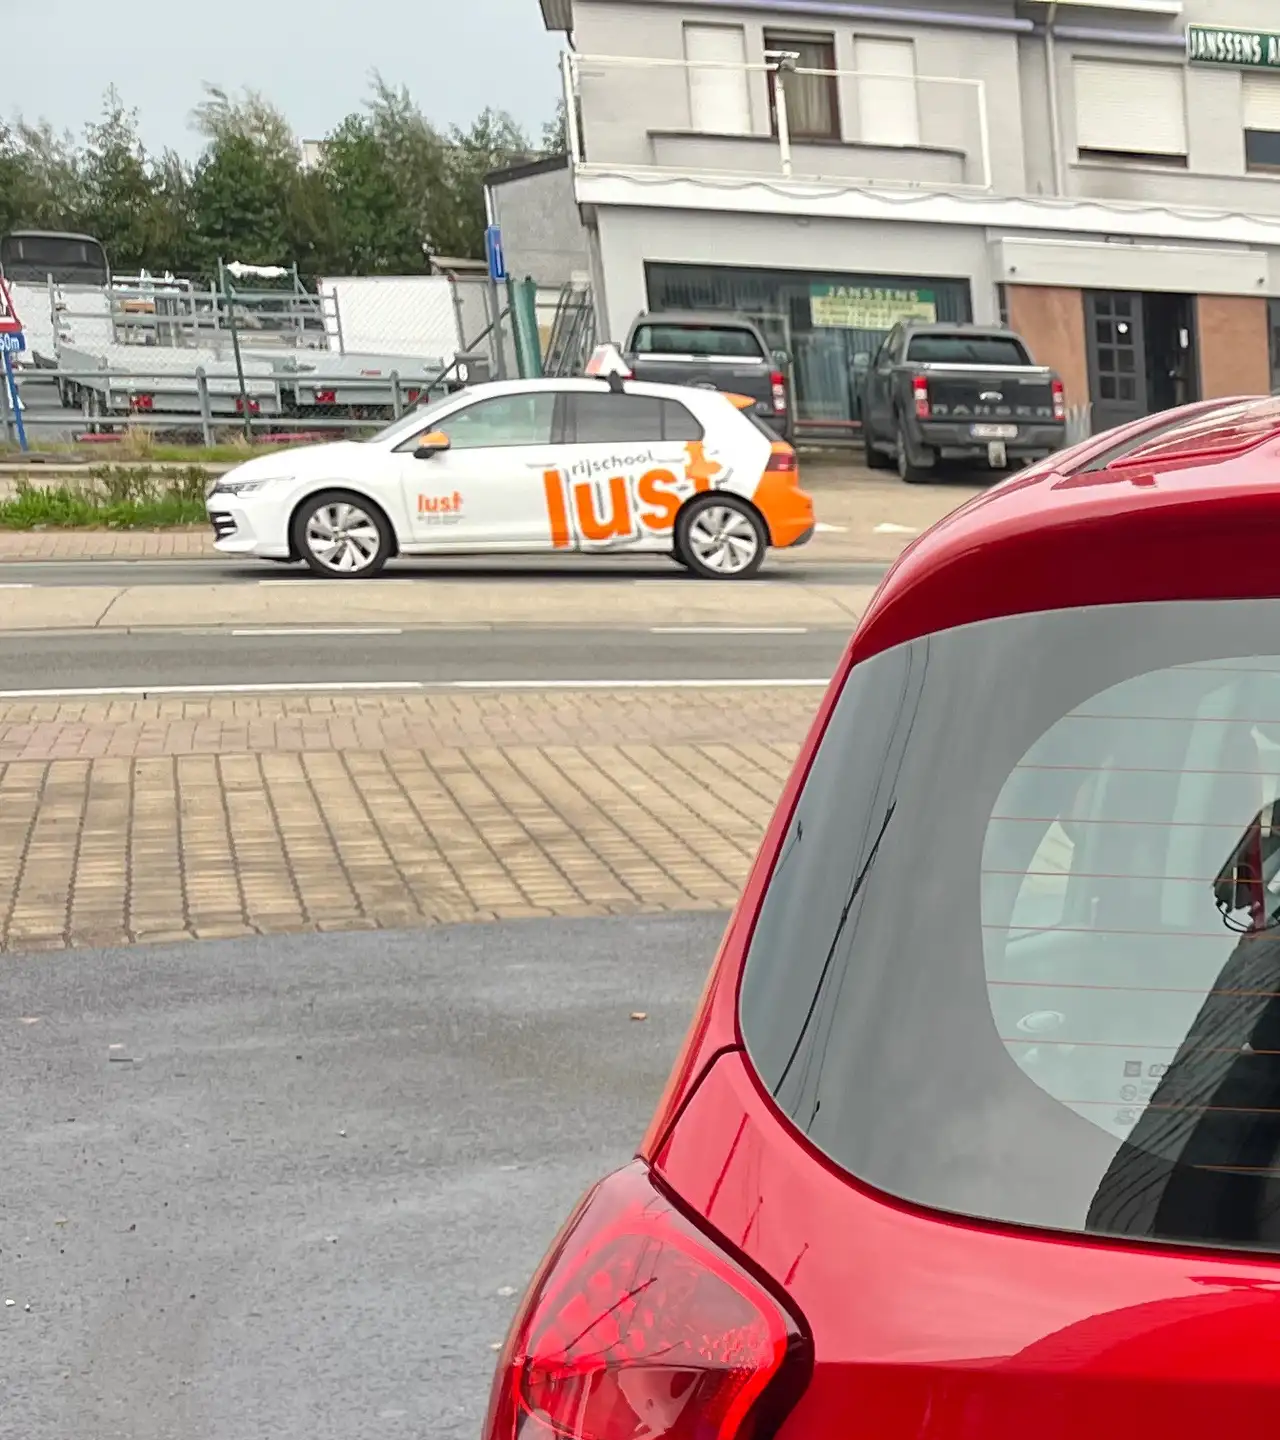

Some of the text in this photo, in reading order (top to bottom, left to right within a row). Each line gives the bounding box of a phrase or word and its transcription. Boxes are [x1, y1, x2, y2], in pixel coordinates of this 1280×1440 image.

[1190, 29, 1261, 64] JANSSENS
[828, 285, 919, 302] JANSSENS
[571, 450, 654, 478] rijschool
[418, 490, 463, 513] lust
[543, 440, 723, 549] lust
